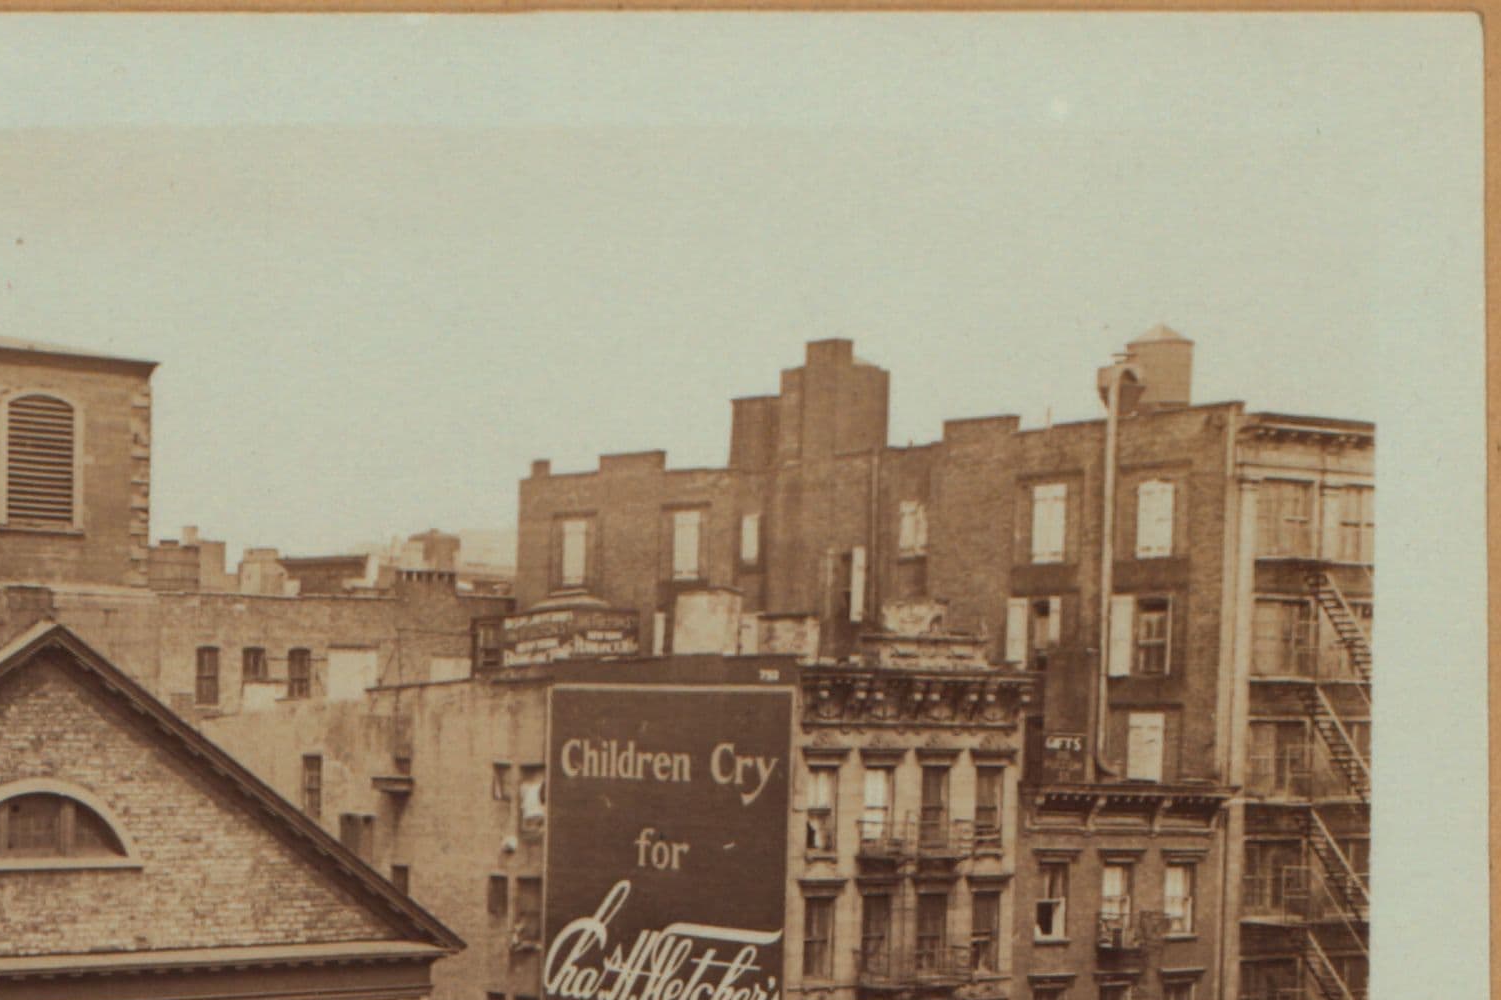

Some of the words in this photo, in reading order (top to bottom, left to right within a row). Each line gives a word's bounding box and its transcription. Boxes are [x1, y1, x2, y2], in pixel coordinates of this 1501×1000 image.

[561, 739, 691, 781] Children
[710, 743, 778, 806] Cry
[635, 828, 689, 870] for
